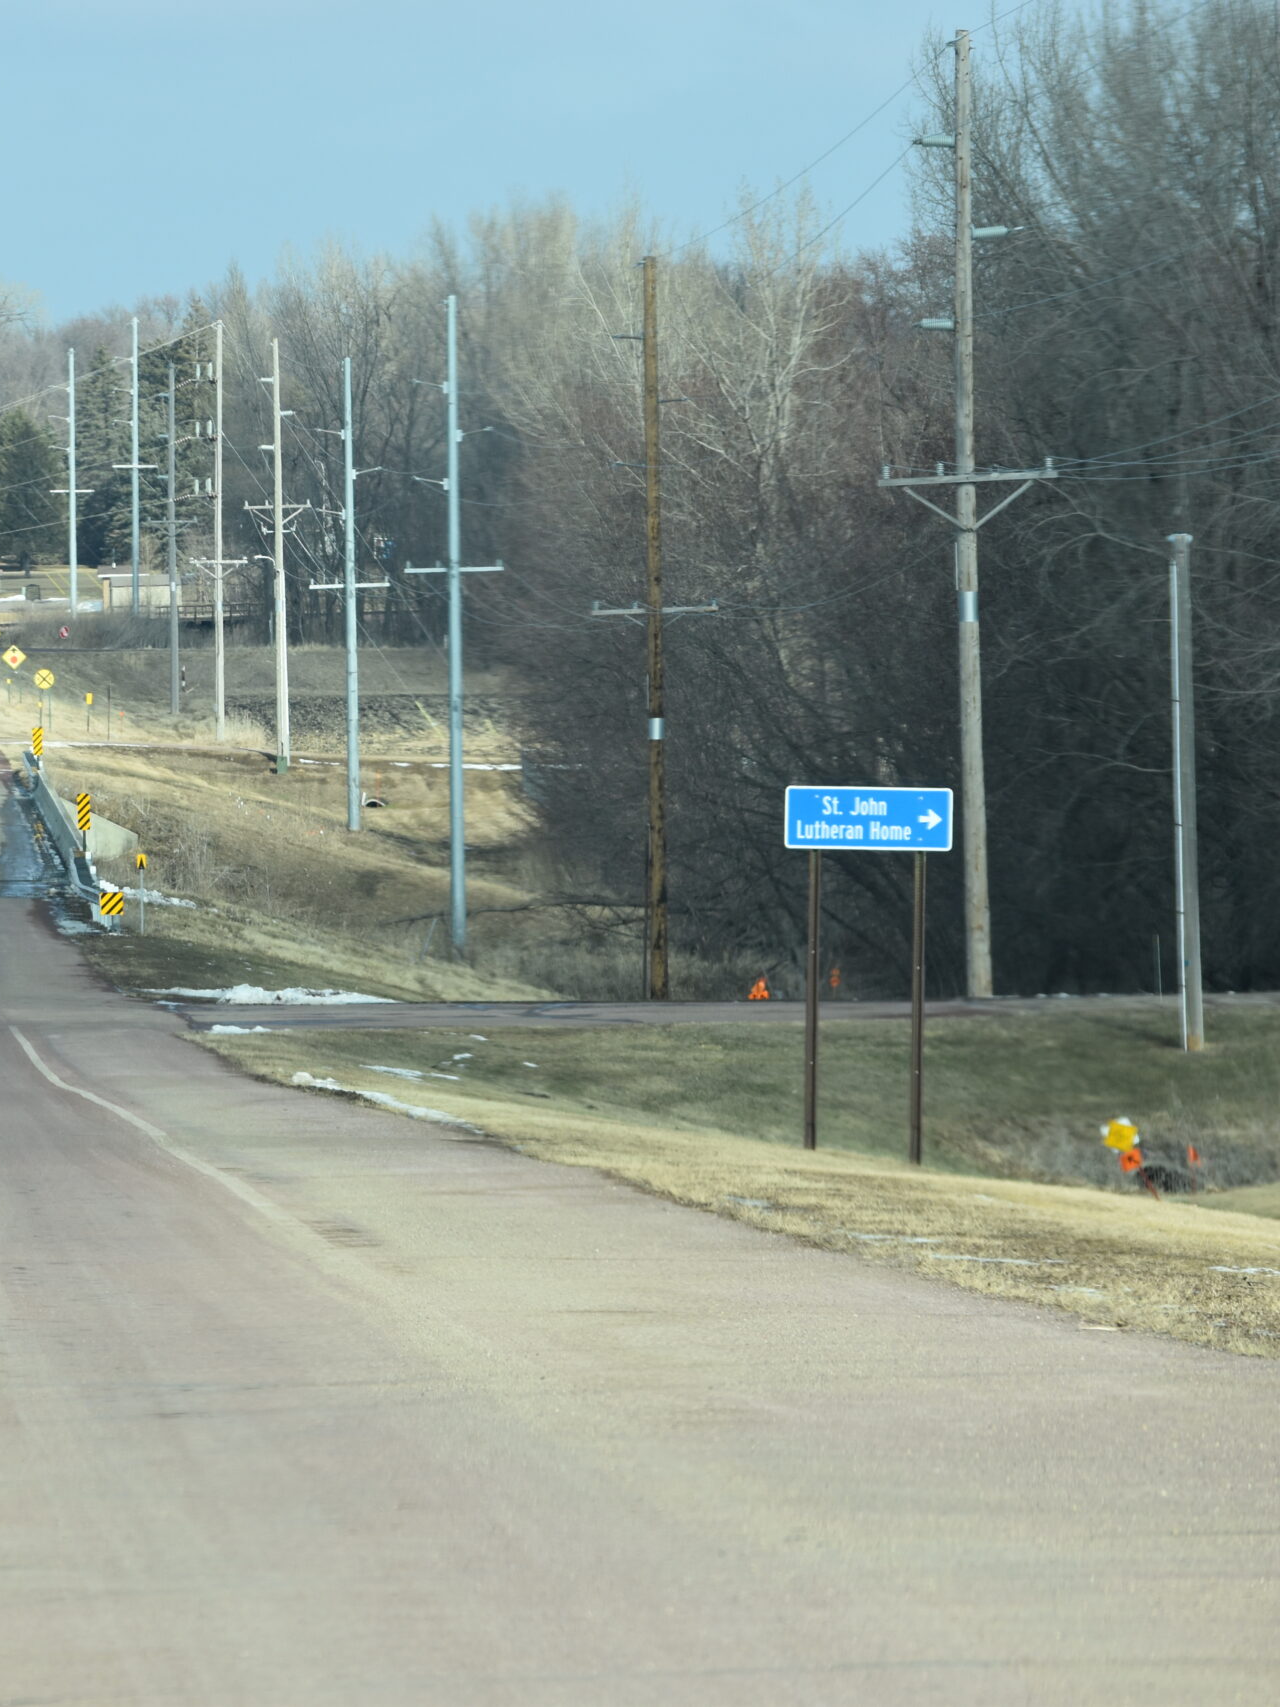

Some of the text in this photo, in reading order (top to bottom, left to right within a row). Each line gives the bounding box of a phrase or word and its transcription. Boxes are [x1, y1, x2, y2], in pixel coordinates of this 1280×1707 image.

[821, 795, 888, 816] St. John
[796, 819, 912, 841] Lutheran Home
